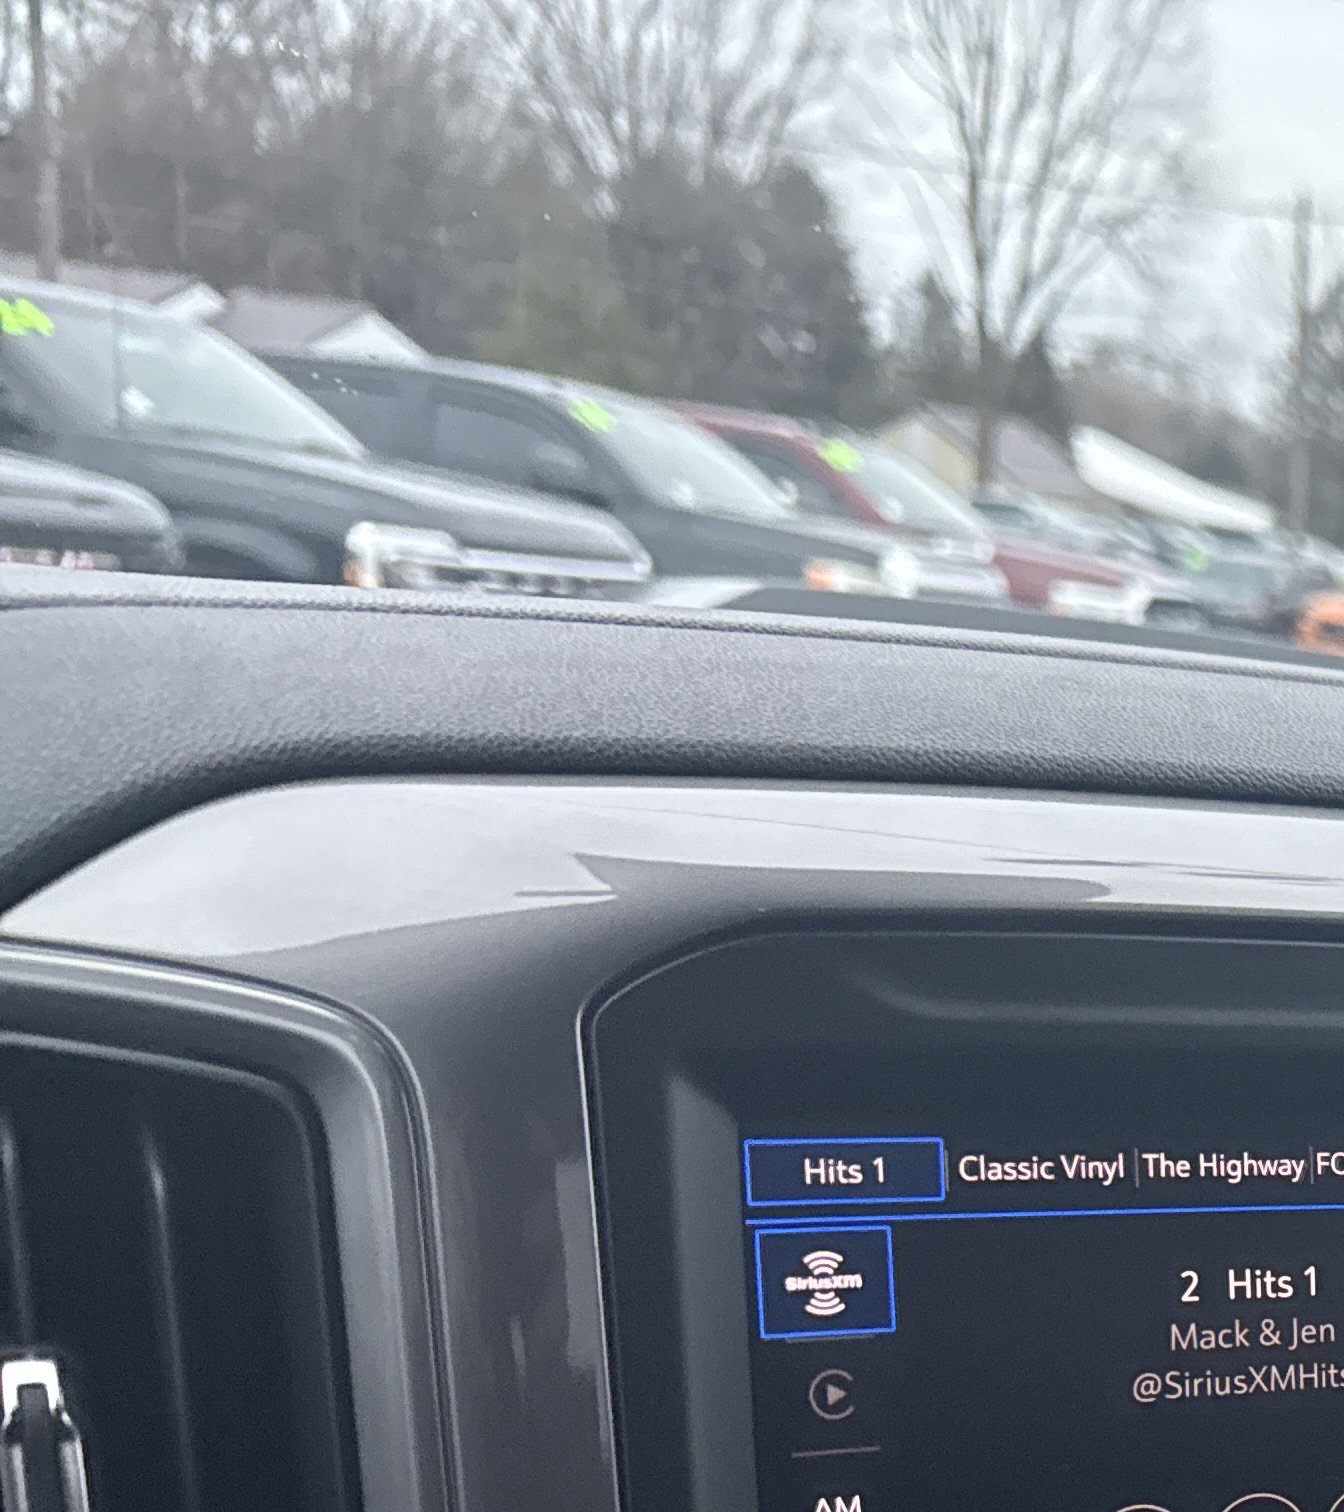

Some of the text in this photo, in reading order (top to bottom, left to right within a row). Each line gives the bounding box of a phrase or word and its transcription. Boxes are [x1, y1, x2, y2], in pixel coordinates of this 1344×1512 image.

[804, 1155, 885, 1185] Hits 1
[958, 1151, 1125, 1186] Classic Vinyl
[1142, 1150, 1305, 1185] The Highway
[1180, 1265, 1317, 1303] 2 Hits 1
[1170, 1316, 1336, 1352] Mack & Jen
